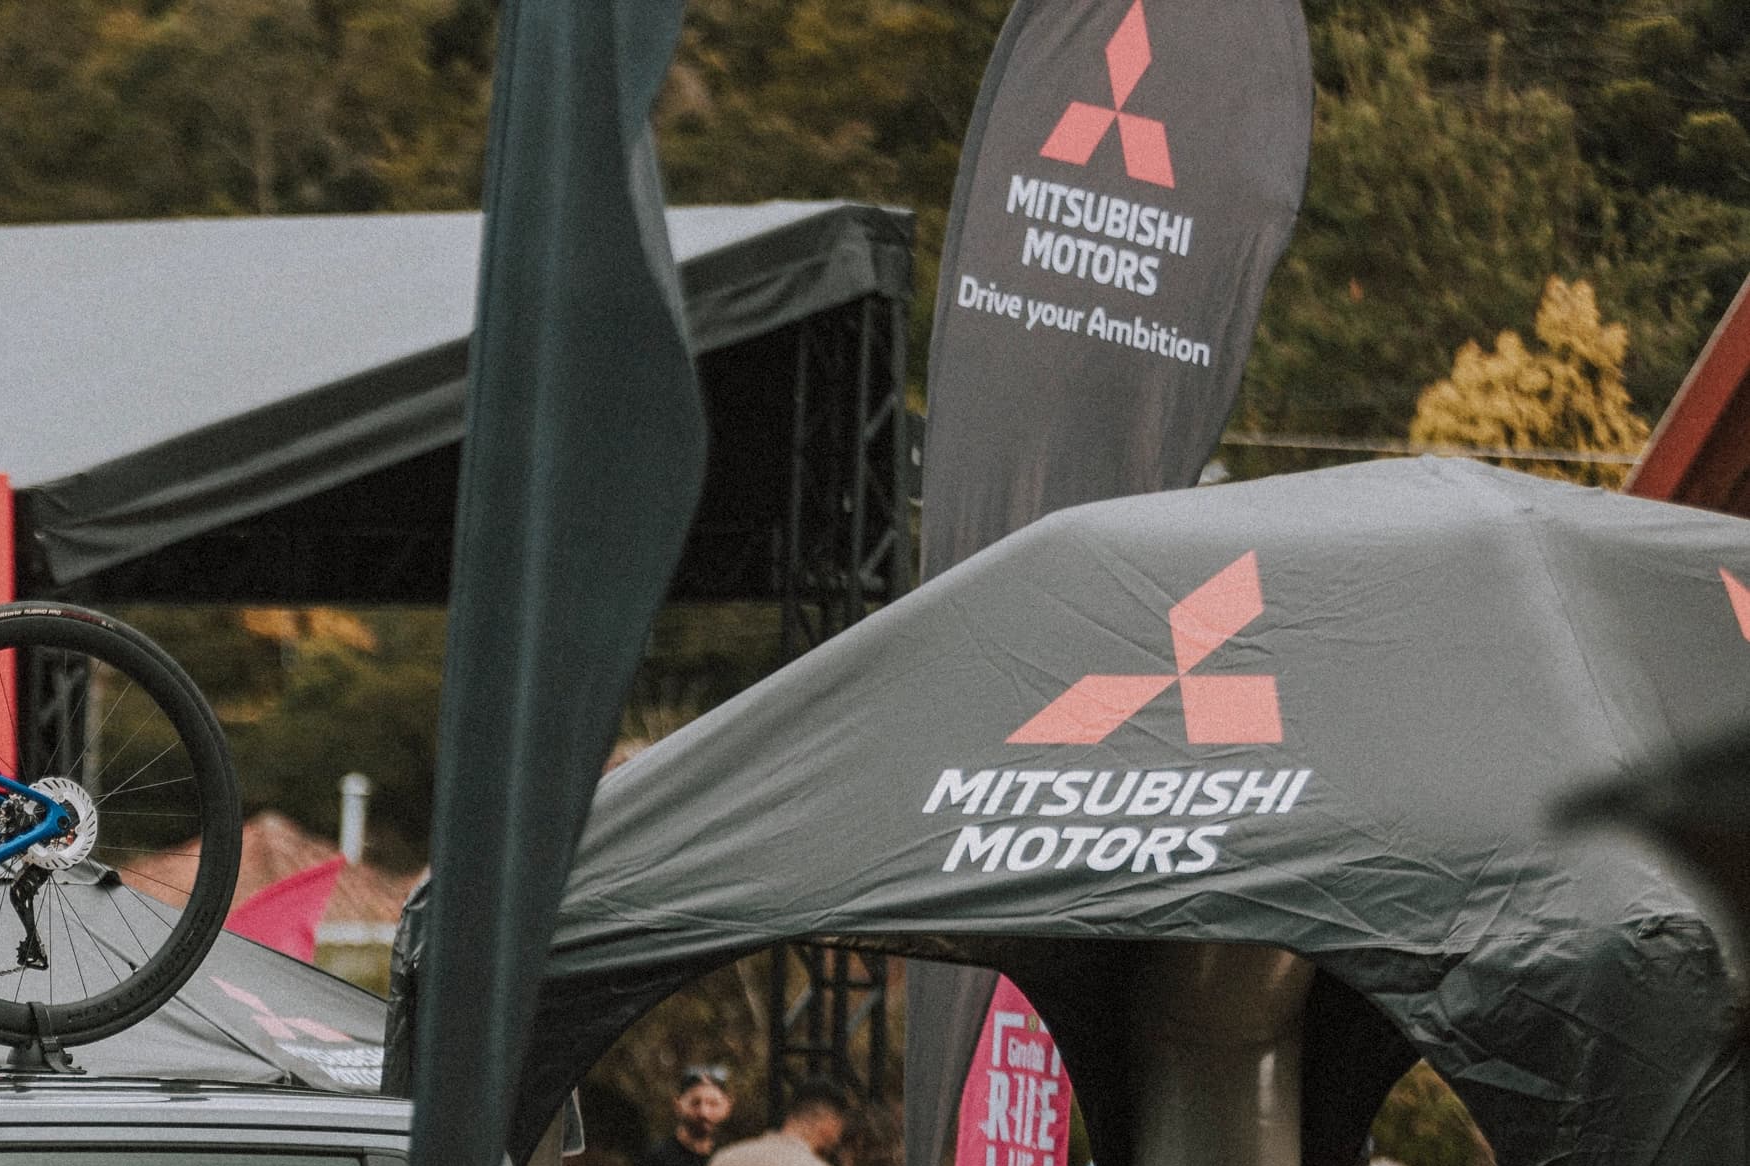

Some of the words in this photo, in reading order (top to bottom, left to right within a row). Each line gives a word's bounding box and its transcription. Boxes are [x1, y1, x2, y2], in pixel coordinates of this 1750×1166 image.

[1006, 175, 1193, 256] MITSUBISHI
[1021, 228, 1159, 296] MOTORS
[957, 275, 1022, 319] Drive
[1026, 299, 1085, 331] your
[1086, 306, 1211, 367] Ambition
[922, 769, 1312, 816] MITSUBISHI
[942, 825, 1229, 873] MOTORS
